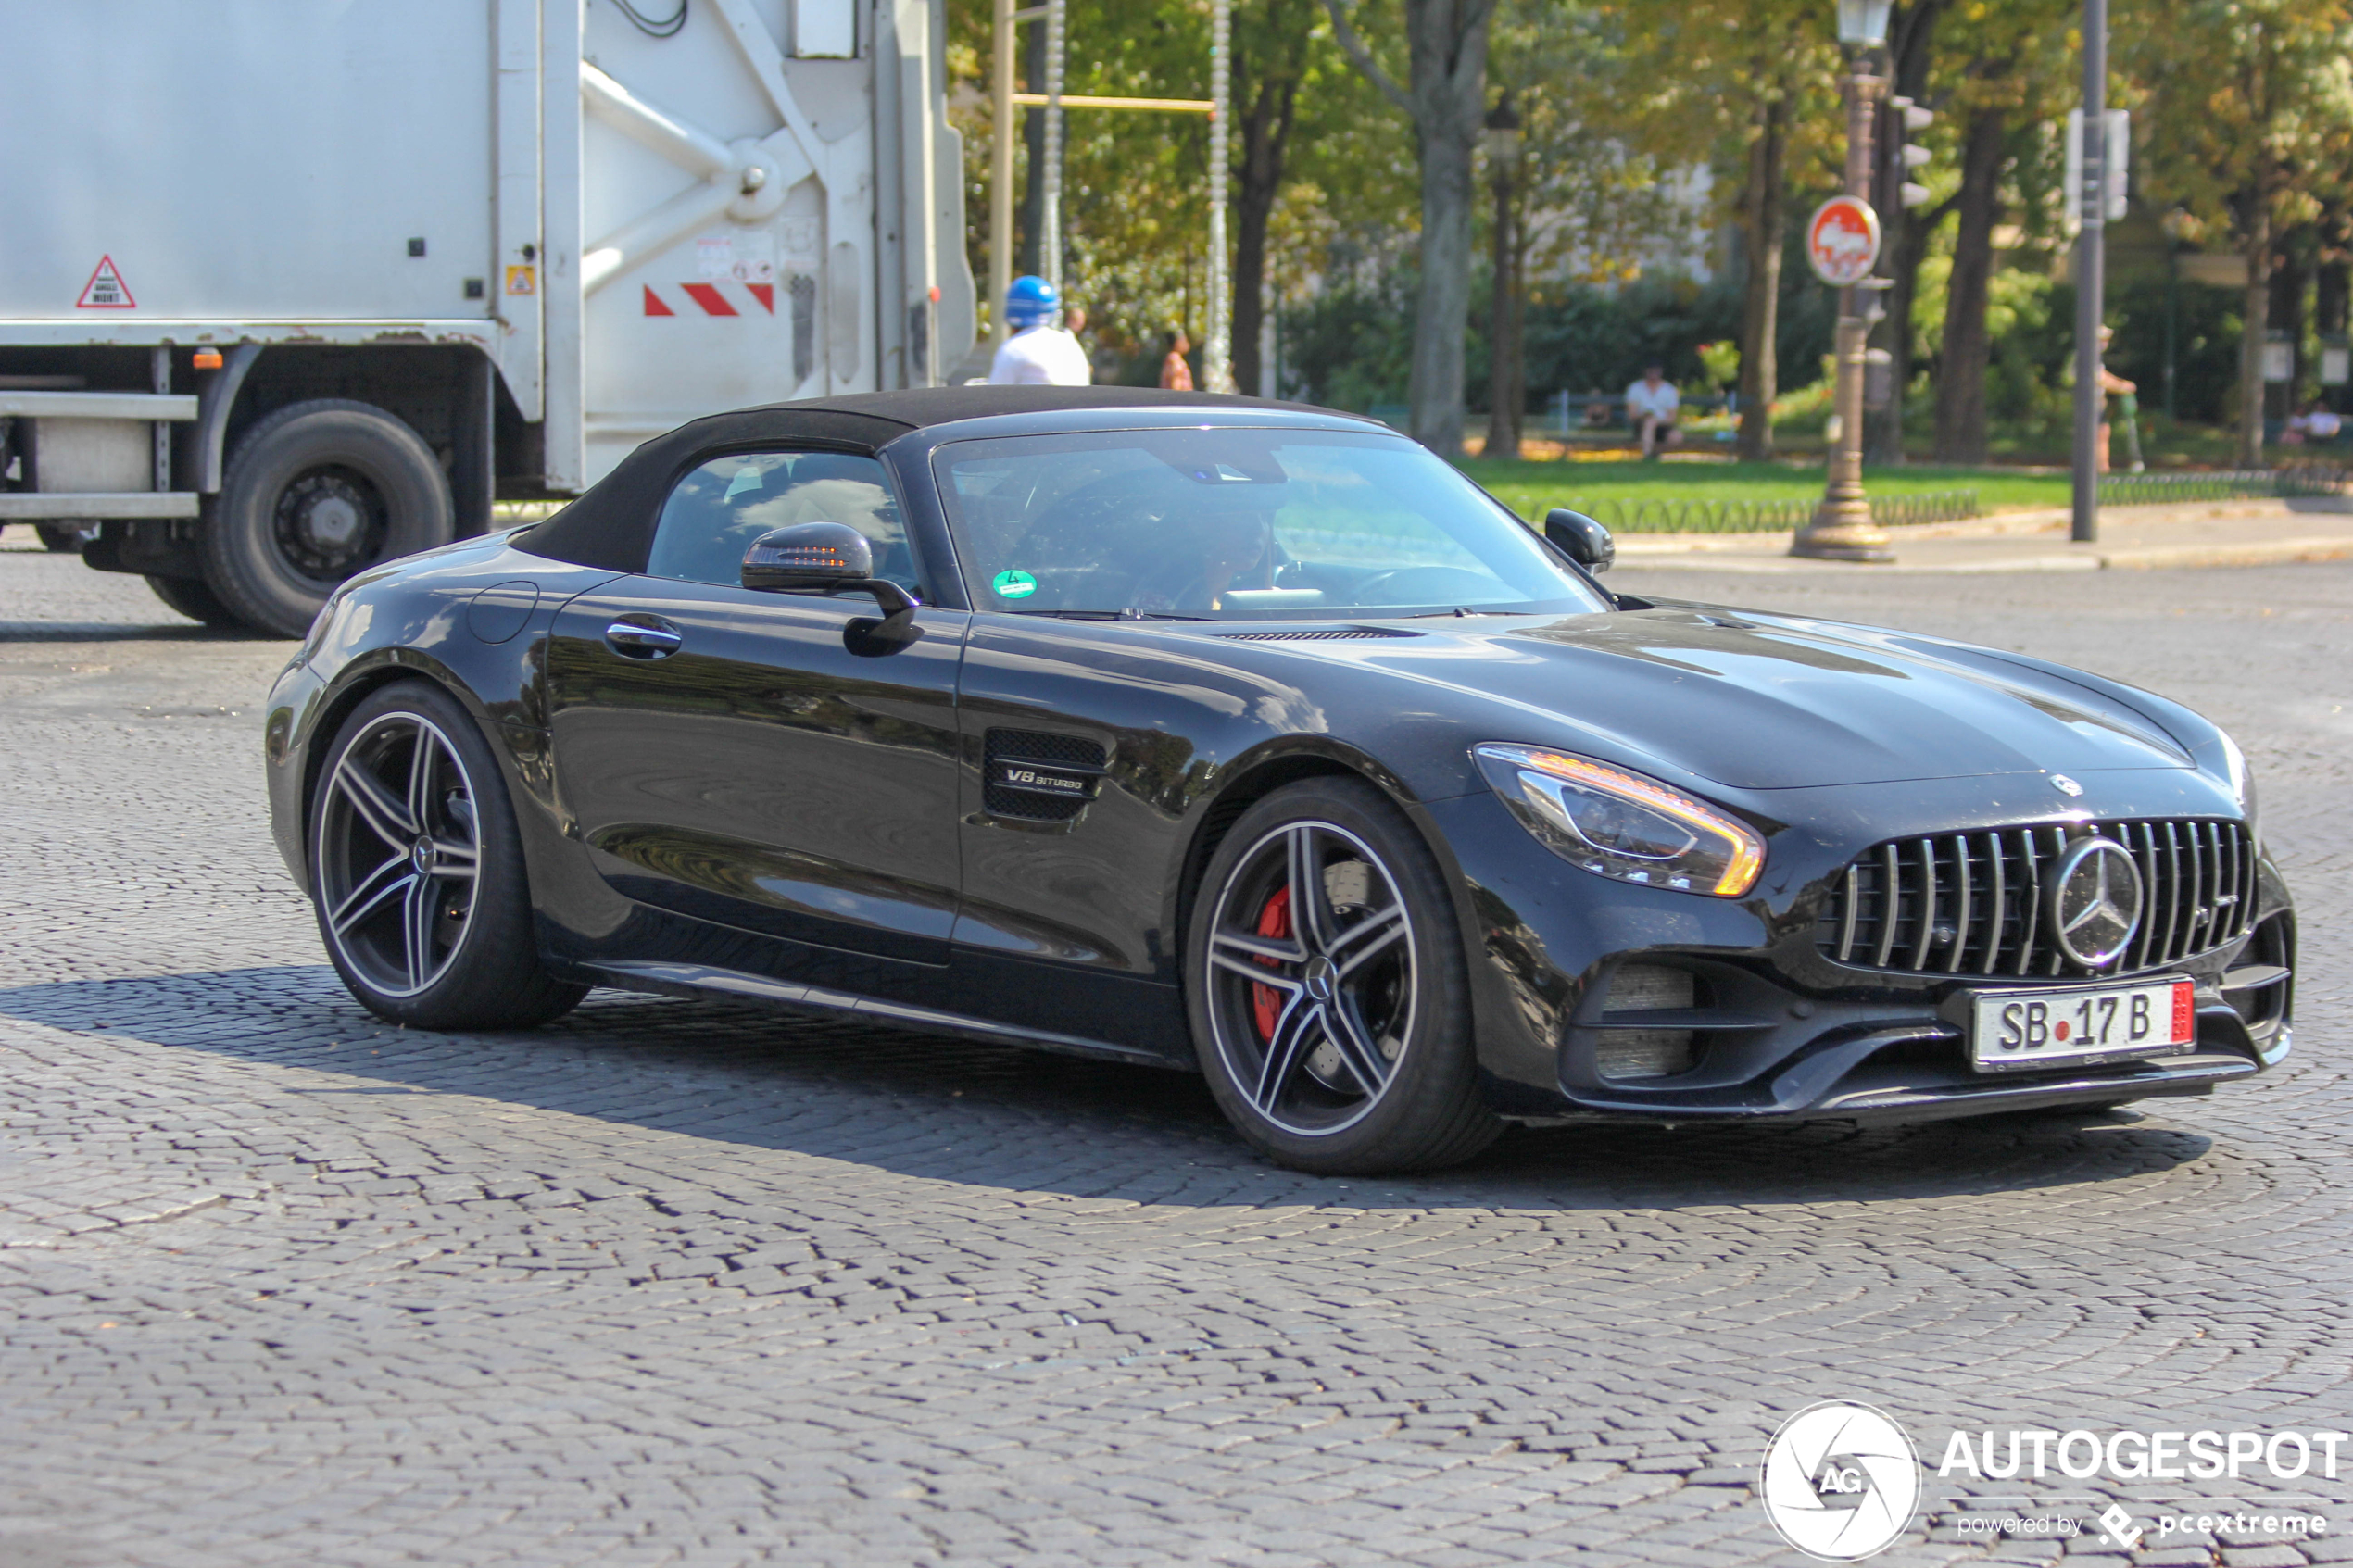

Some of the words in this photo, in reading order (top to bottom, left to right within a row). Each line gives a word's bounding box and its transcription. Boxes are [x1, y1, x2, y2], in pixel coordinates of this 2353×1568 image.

[1007, 571, 1020, 584] 4
[1007, 769, 1035, 783] V8
[1036, 776, 1083, 789] BITURBO
[1999, 1000, 2048, 1051] SB
[2073, 997, 2120, 1047] 17
[2131, 994, 2150, 1041] B
